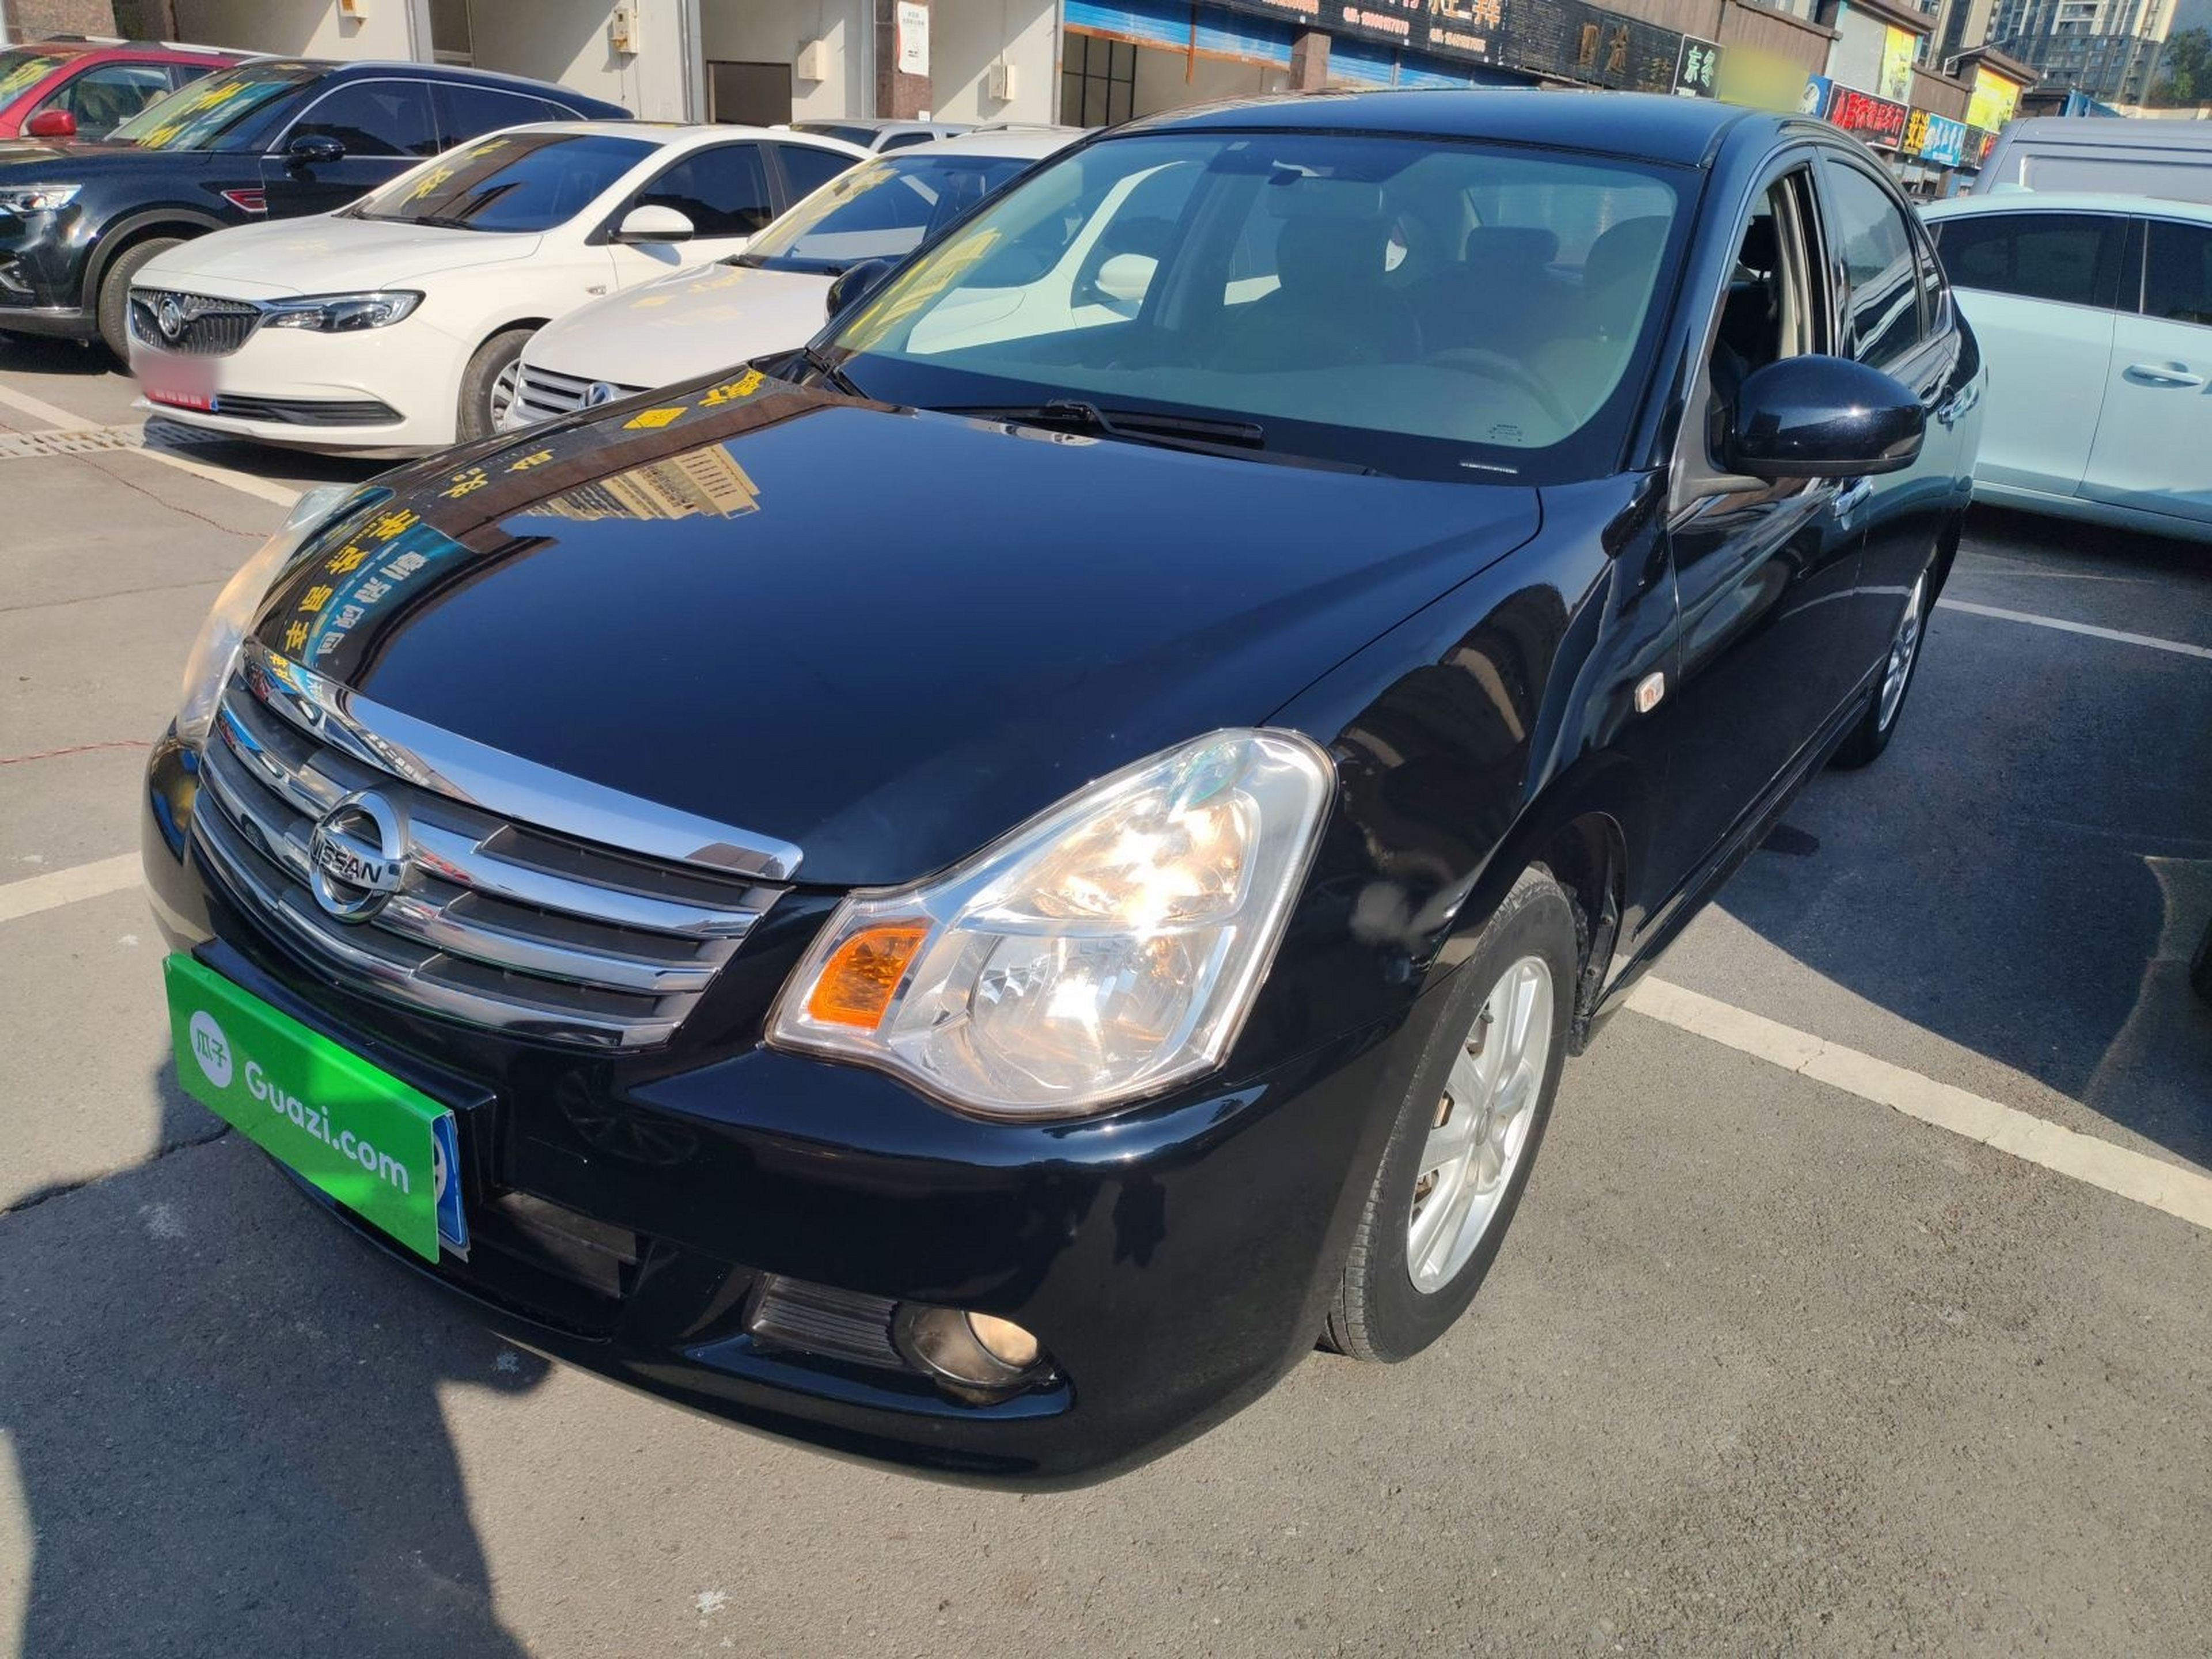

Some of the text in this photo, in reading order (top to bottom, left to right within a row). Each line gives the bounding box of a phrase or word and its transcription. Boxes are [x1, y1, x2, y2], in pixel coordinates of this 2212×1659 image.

[310, 830, 382, 884] NISSAN
[196, 1028, 228, 1069] 瓜子
[245, 1060, 409, 1194] Guazi.com
